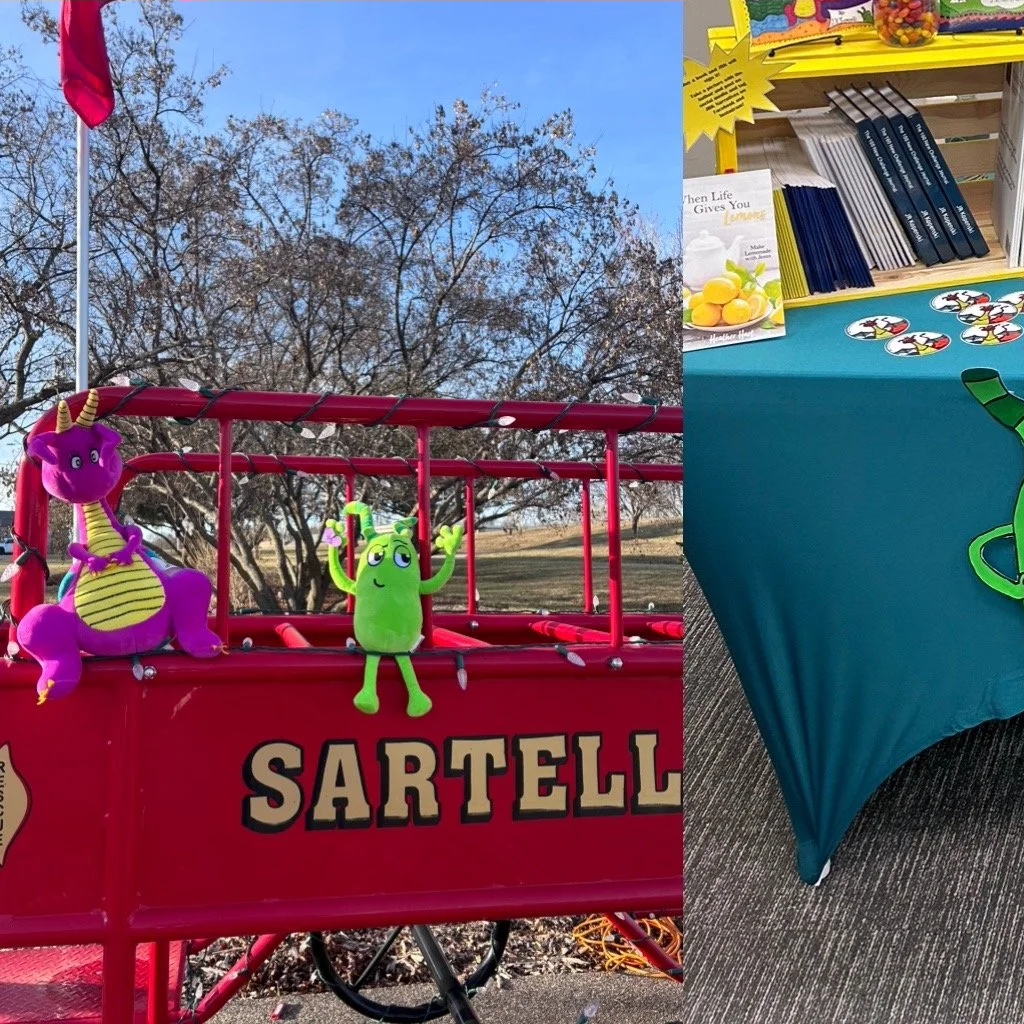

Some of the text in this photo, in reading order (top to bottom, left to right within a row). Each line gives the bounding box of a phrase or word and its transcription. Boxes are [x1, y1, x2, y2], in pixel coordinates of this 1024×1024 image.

[877, 156, 890, 178] Challenge
[893, 153, 906, 174] Challenge
[911, 150, 923, 172] Challenge
[928, 149, 941, 170] Challenge
[683, 190, 733, 204] hen Life
[693, 200, 750, 214] Gives You
[909, 219, 923, 243] Kopenski
[924, 216, 940, 239] Kopenski
[943, 212, 958, 236] Kopenski
[960, 211, 975, 234] Kopenski
[243, 731, 682, 833] SARTELL
